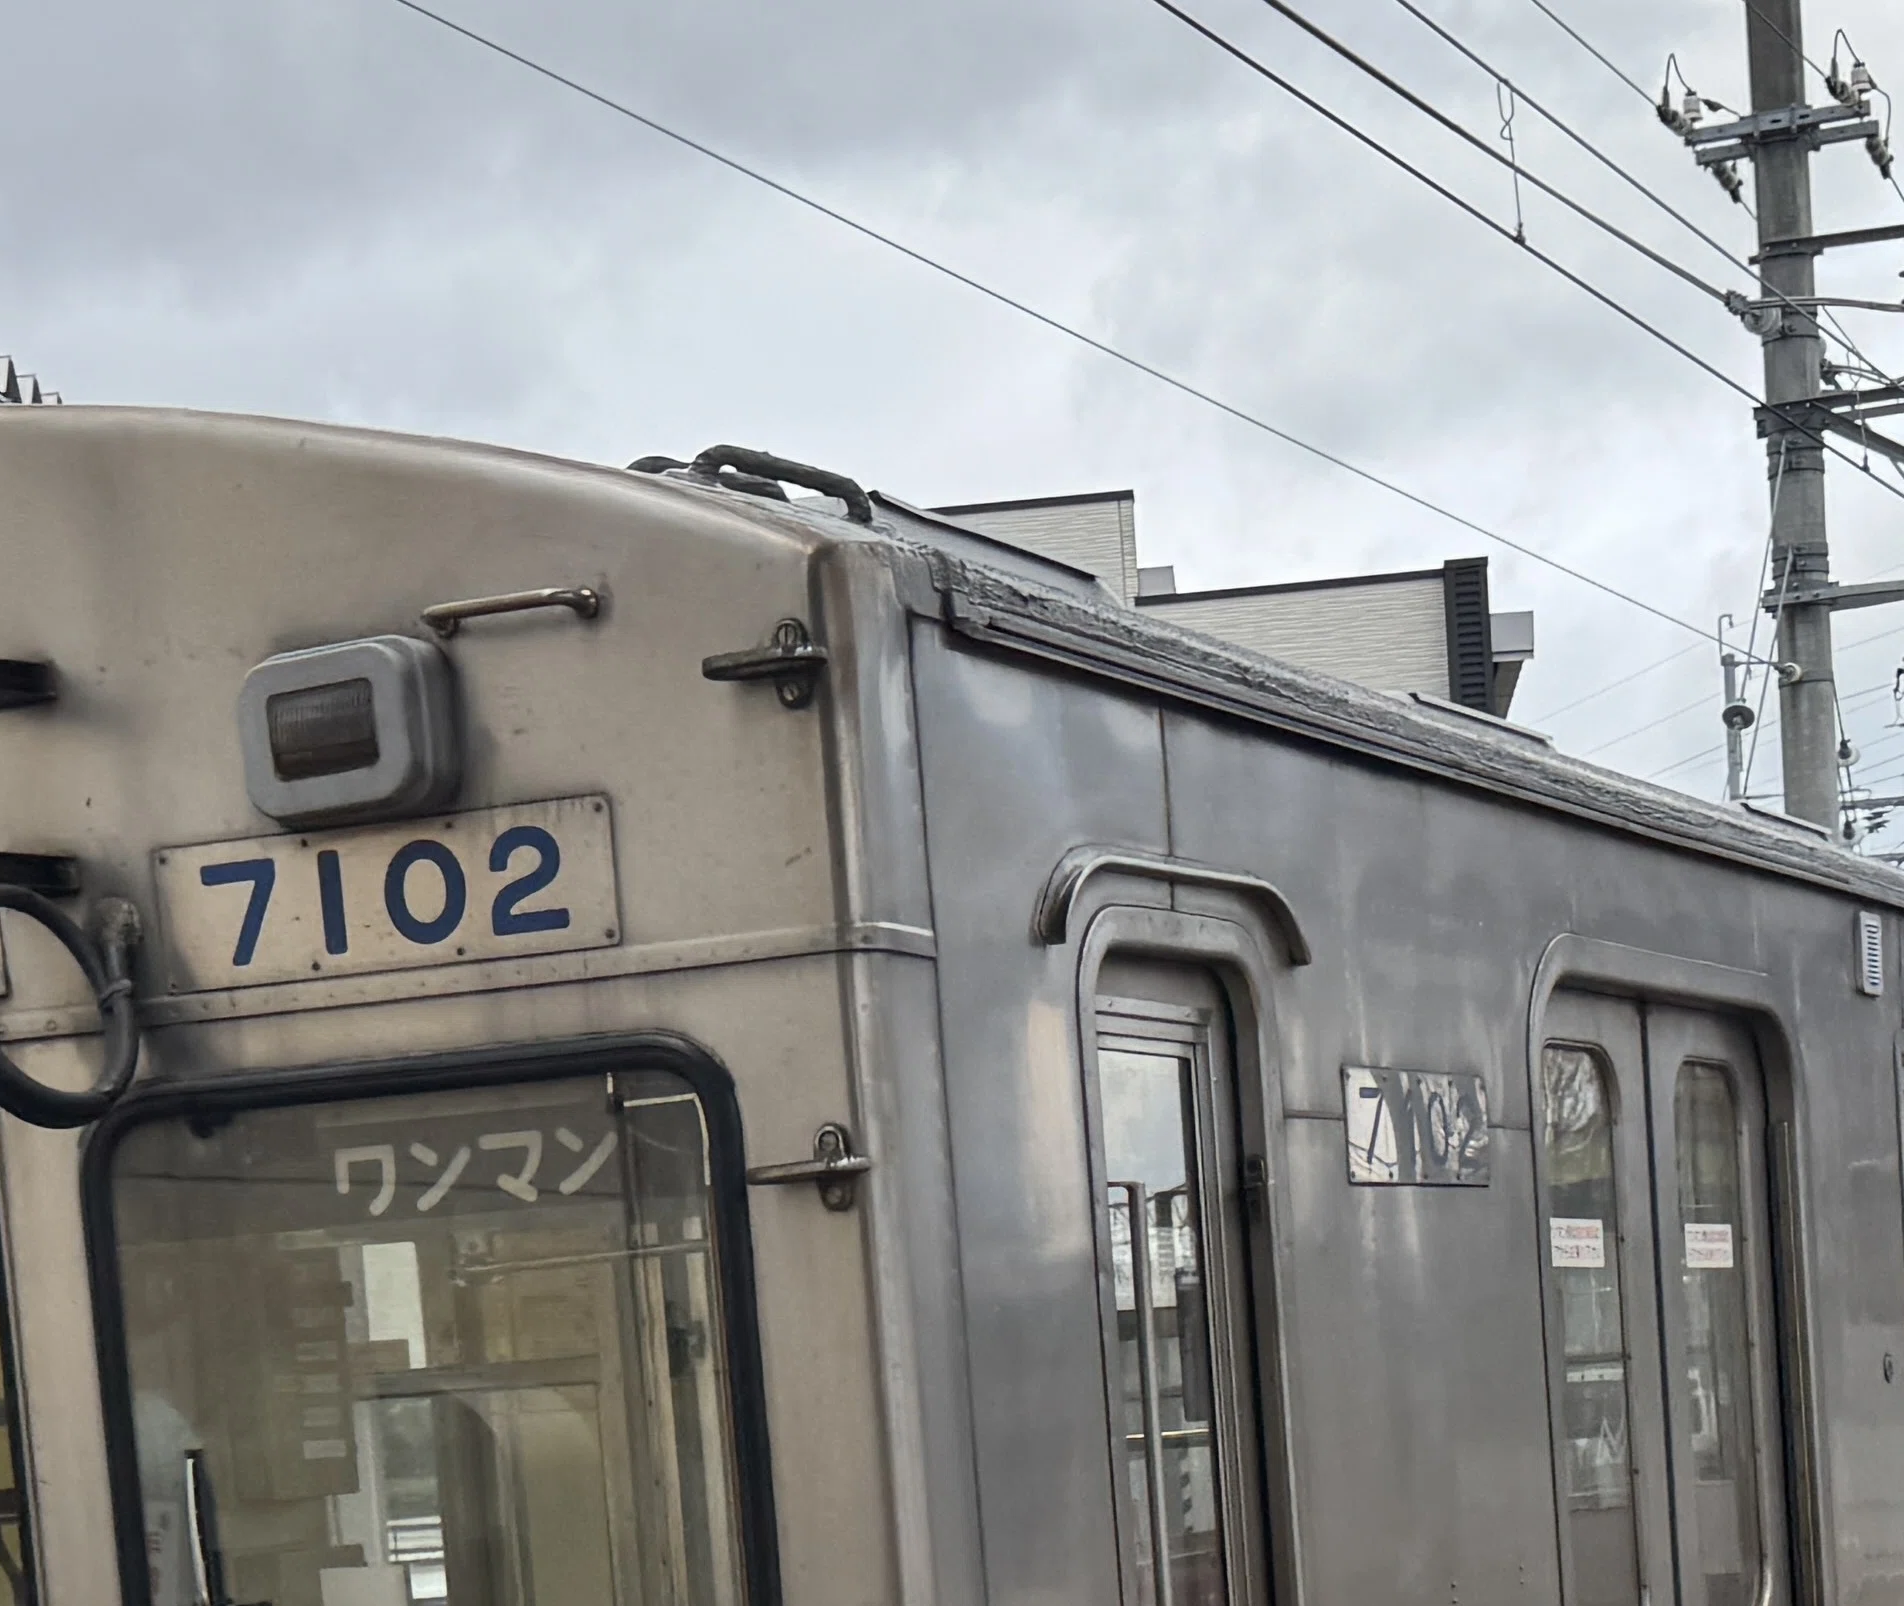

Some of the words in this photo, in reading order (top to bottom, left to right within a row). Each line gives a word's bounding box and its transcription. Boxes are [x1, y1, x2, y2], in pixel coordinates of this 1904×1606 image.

[199, 825, 570, 967] 7102
[334, 1126, 619, 1216] ワンマン
